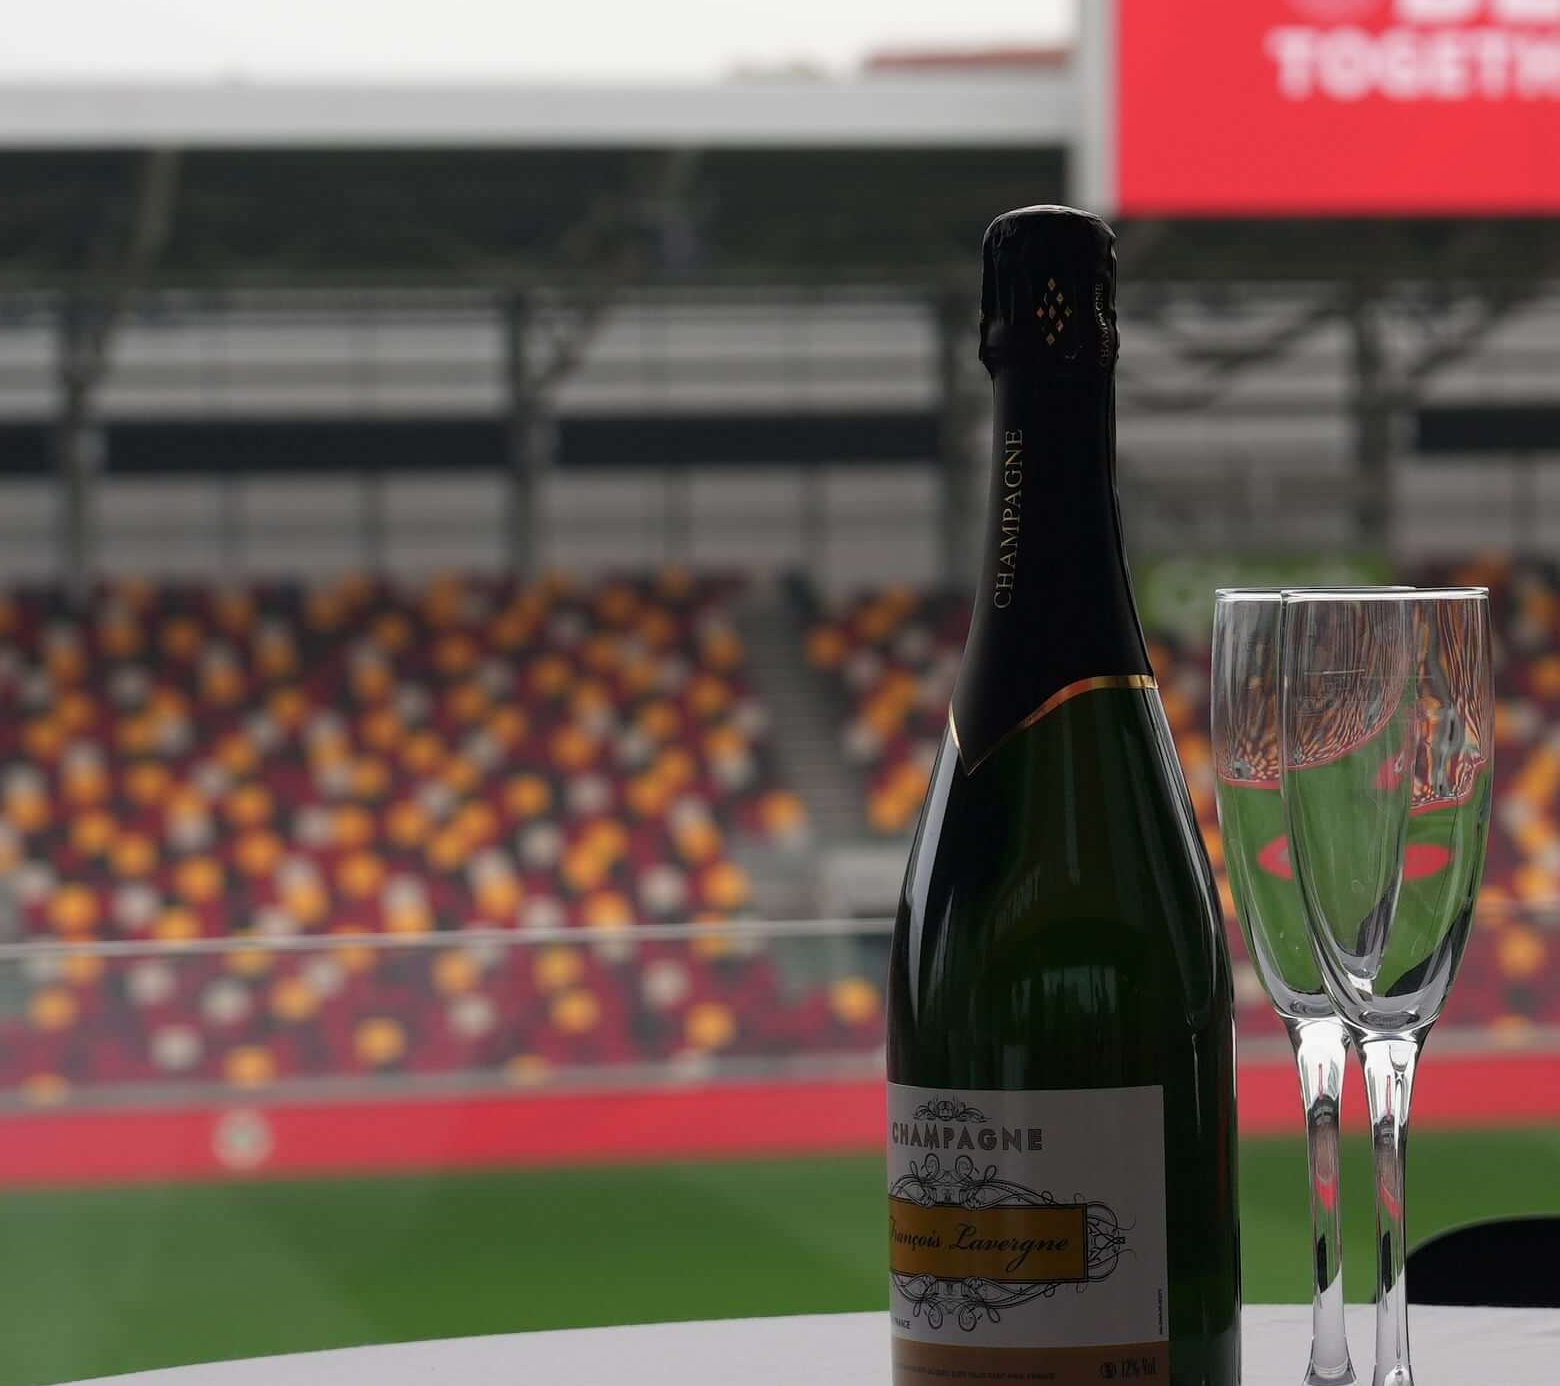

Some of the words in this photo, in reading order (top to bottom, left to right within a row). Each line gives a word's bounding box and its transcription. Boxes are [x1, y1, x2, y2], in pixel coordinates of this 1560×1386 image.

[993, 428, 1024, 609] CHAMPAGNE
[892, 1121, 1043, 1152] CHAMPAGNE
[948, 1222, 1071, 1272] Lavergne
